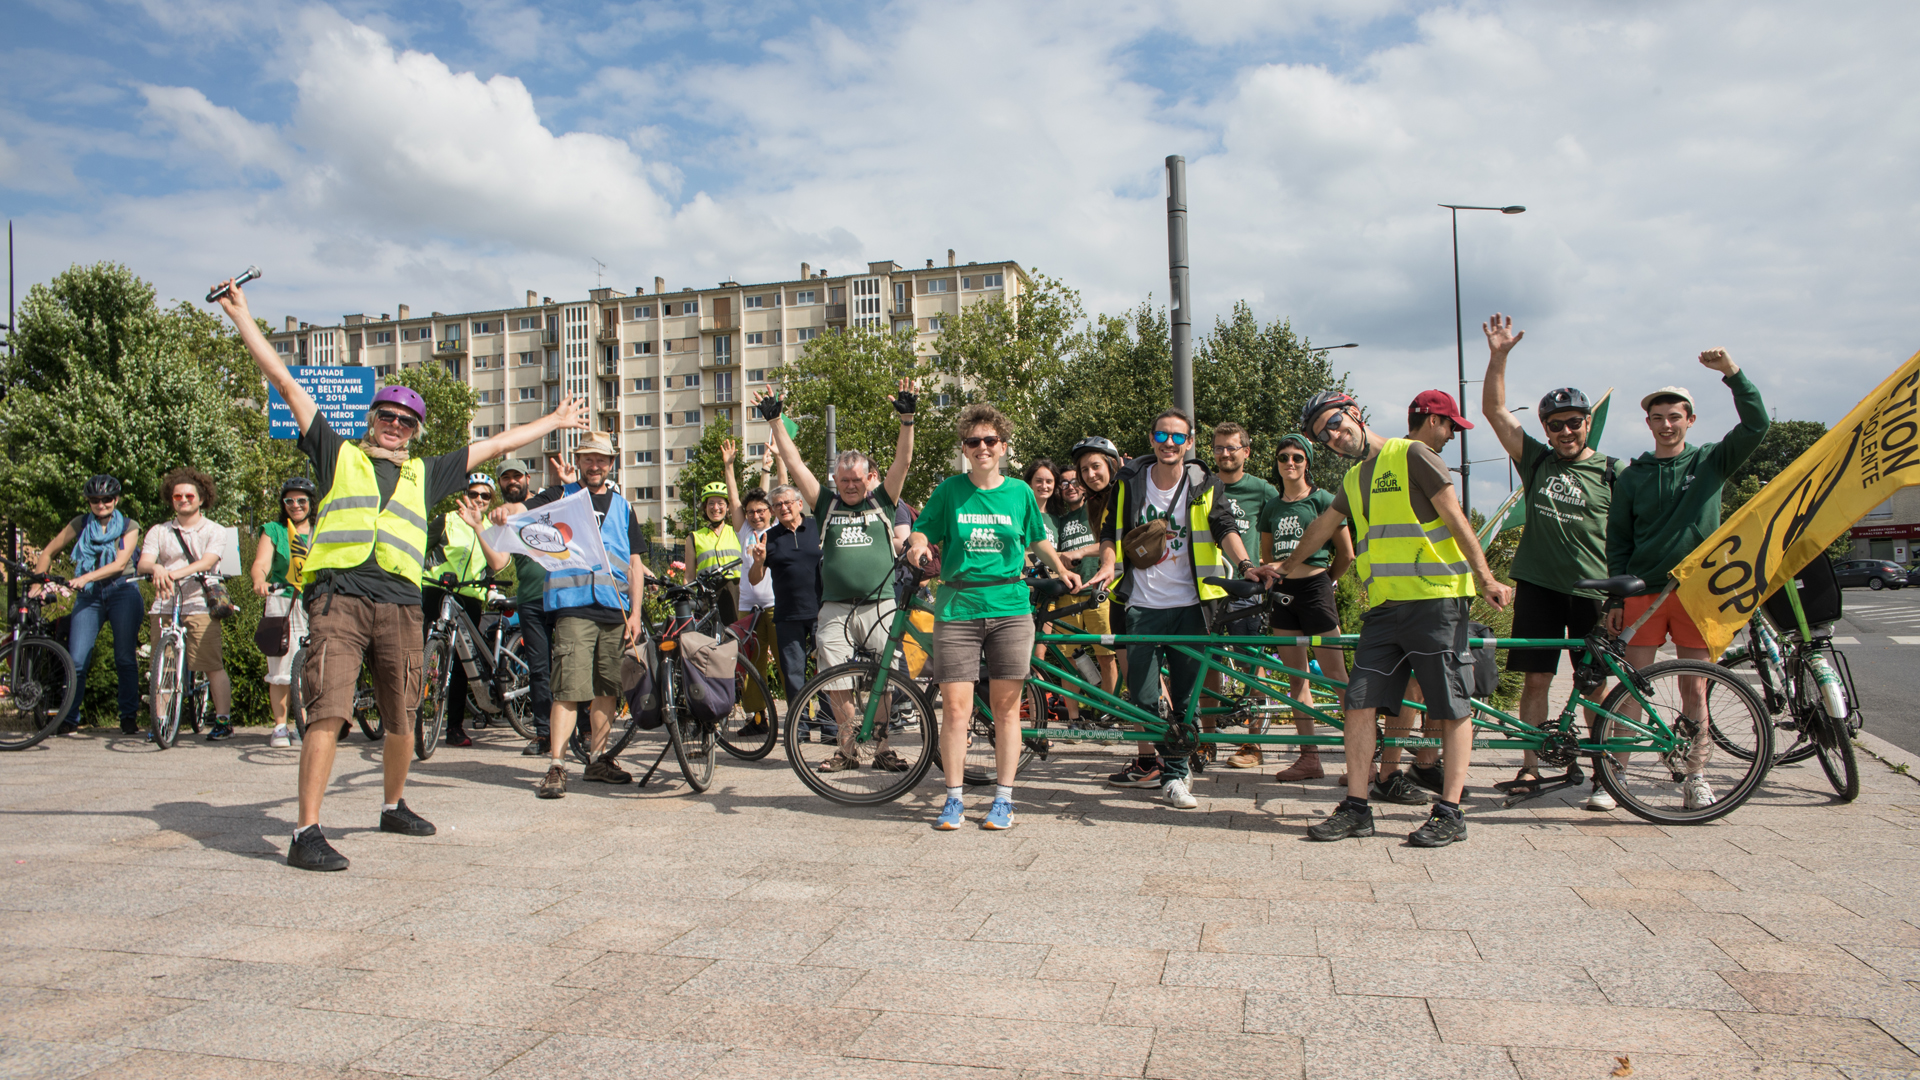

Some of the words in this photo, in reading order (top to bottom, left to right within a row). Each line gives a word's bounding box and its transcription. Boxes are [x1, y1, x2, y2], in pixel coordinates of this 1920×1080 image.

[300, 369, 344, 377] ESPLANADE
[319, 377, 362, 385] GENDARMERIE
[302, 386, 315, 394] UD
[317, 385, 364, 394] BELTRAME
[325, 394, 347, 402] 2018
[330, 411, 355, 419] HÉROS
[1881, 368, 1920, 477] CTION
[332, 428, 355, 437] UDE)
[1374, 476, 1398, 489] TOUR
[1545, 475, 1583, 499] TOUR
[957, 513, 1013, 526] ALTERNATIBA
[1700, 534, 1760, 616] COP
[1037, 728, 1125, 740] PEDALPOWER
[1394, 737, 1490, 749] PEDALER
